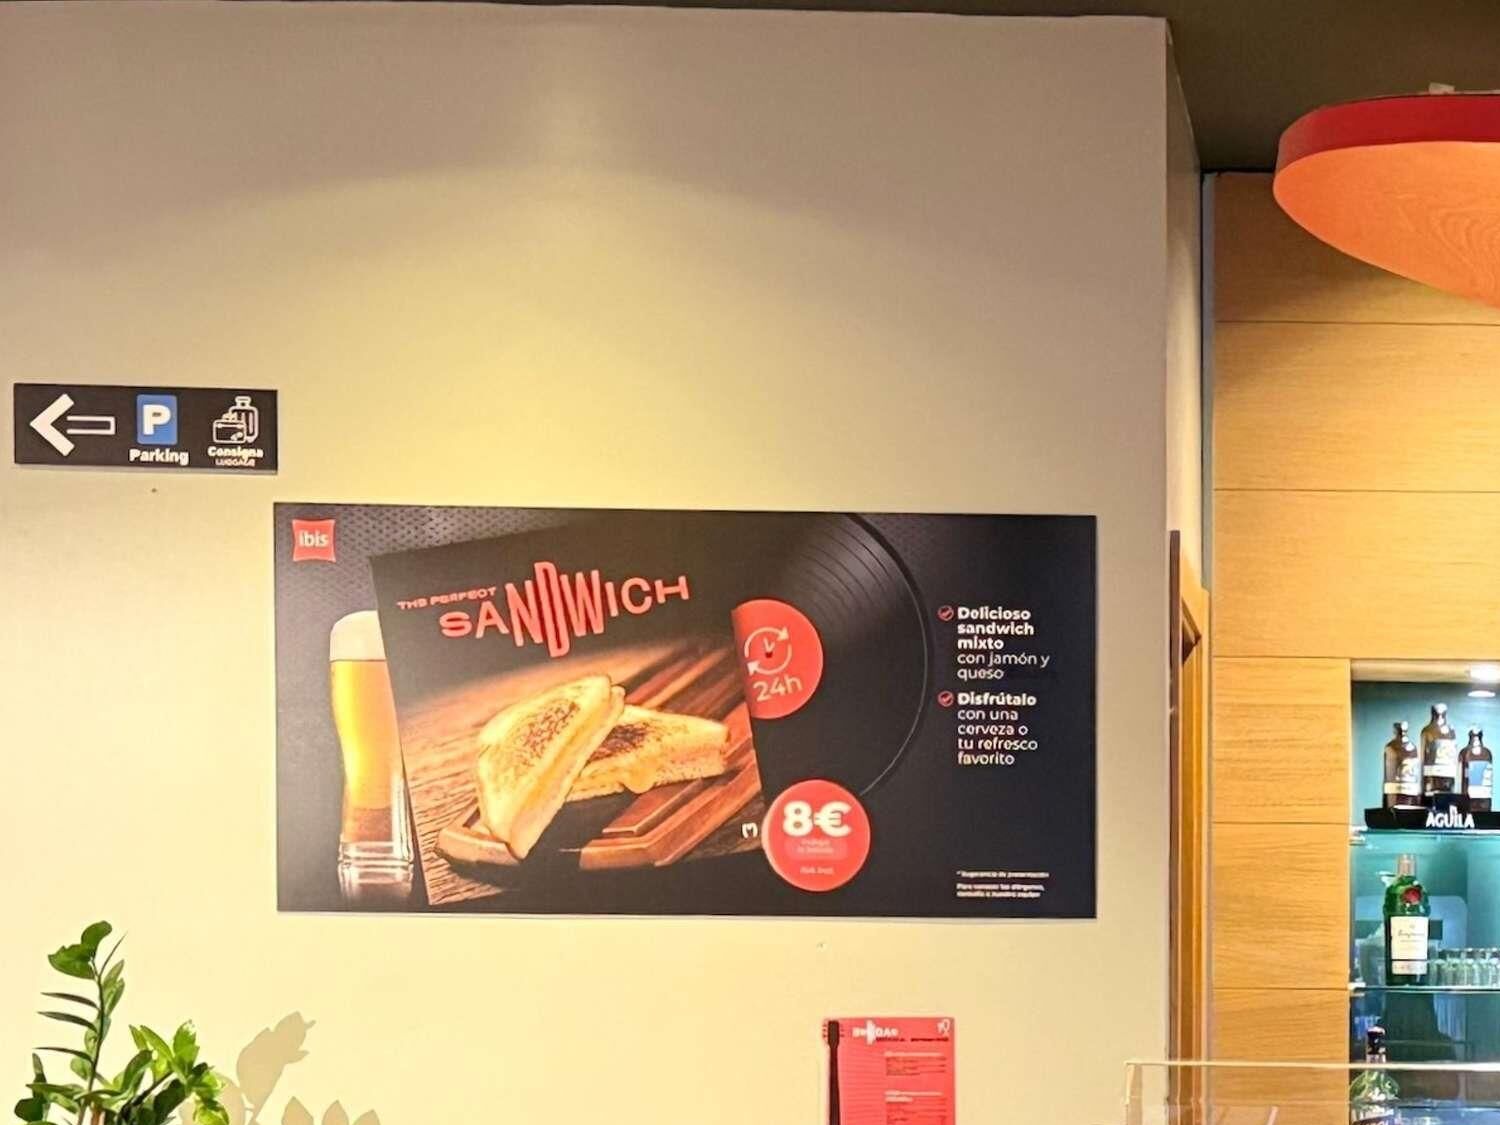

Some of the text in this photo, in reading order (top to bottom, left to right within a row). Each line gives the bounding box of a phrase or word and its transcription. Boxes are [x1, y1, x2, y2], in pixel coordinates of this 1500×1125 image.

[143, 404, 171, 435] P
[129, 448, 189, 466] Parking
[207, 446, 264, 461] Consigna
[299, 529, 329, 547] ibis
[430, 586, 497, 605] PERFECT
[439, 561, 690, 657] SANDWICH
[957, 606, 1031, 621] Delicioso
[957, 621, 1035, 636] sandwich
[957, 636, 1005, 650] mixto
[957, 651, 1051, 668] con jamón y
[957, 668, 1005, 682] queso
[753, 677, 803, 702] 24h
[957, 691, 1038, 706] Disfrútalo
[957, 709, 1019, 720] con una
[957, 724, 1029, 736] cerveza o
[957, 737, 1039, 750] tu refresco
[957, 751, 1016, 766] favorito
[782, 800, 853, 837] 8€
